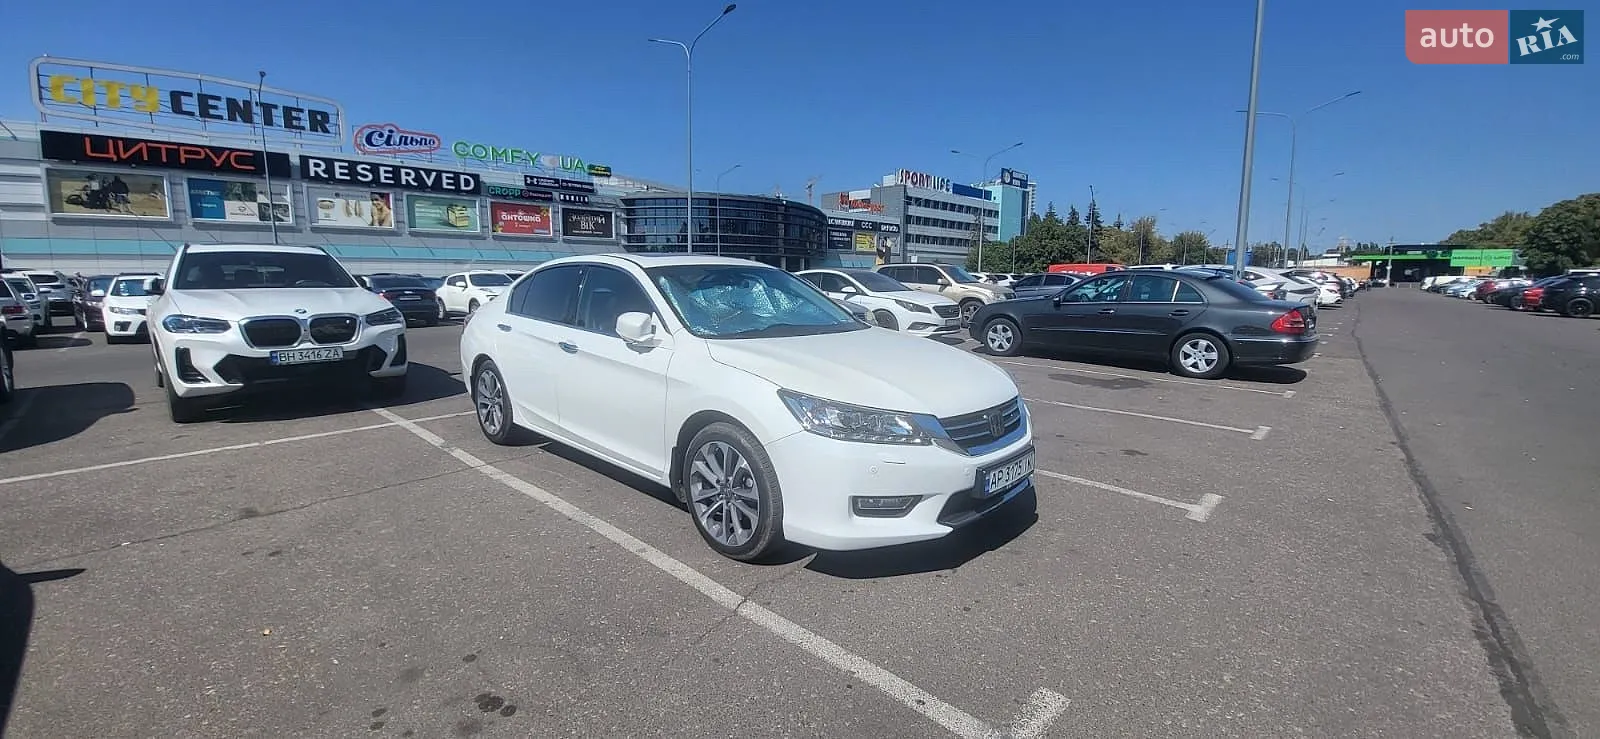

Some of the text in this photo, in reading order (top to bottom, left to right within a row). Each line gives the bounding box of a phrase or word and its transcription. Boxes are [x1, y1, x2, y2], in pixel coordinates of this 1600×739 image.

[49, 74, 331, 134] CITY CENTER
[84, 136, 256, 170] ЦИТРУС
[365, 129, 436, 148] Сільпо
[452, 140, 539, 168] COMFY
[559, 155, 588, 173] UA
[308, 158, 476, 191] RESERVED
[279, 352, 295, 362] BH
[990, 468, 1004, 489] AP
